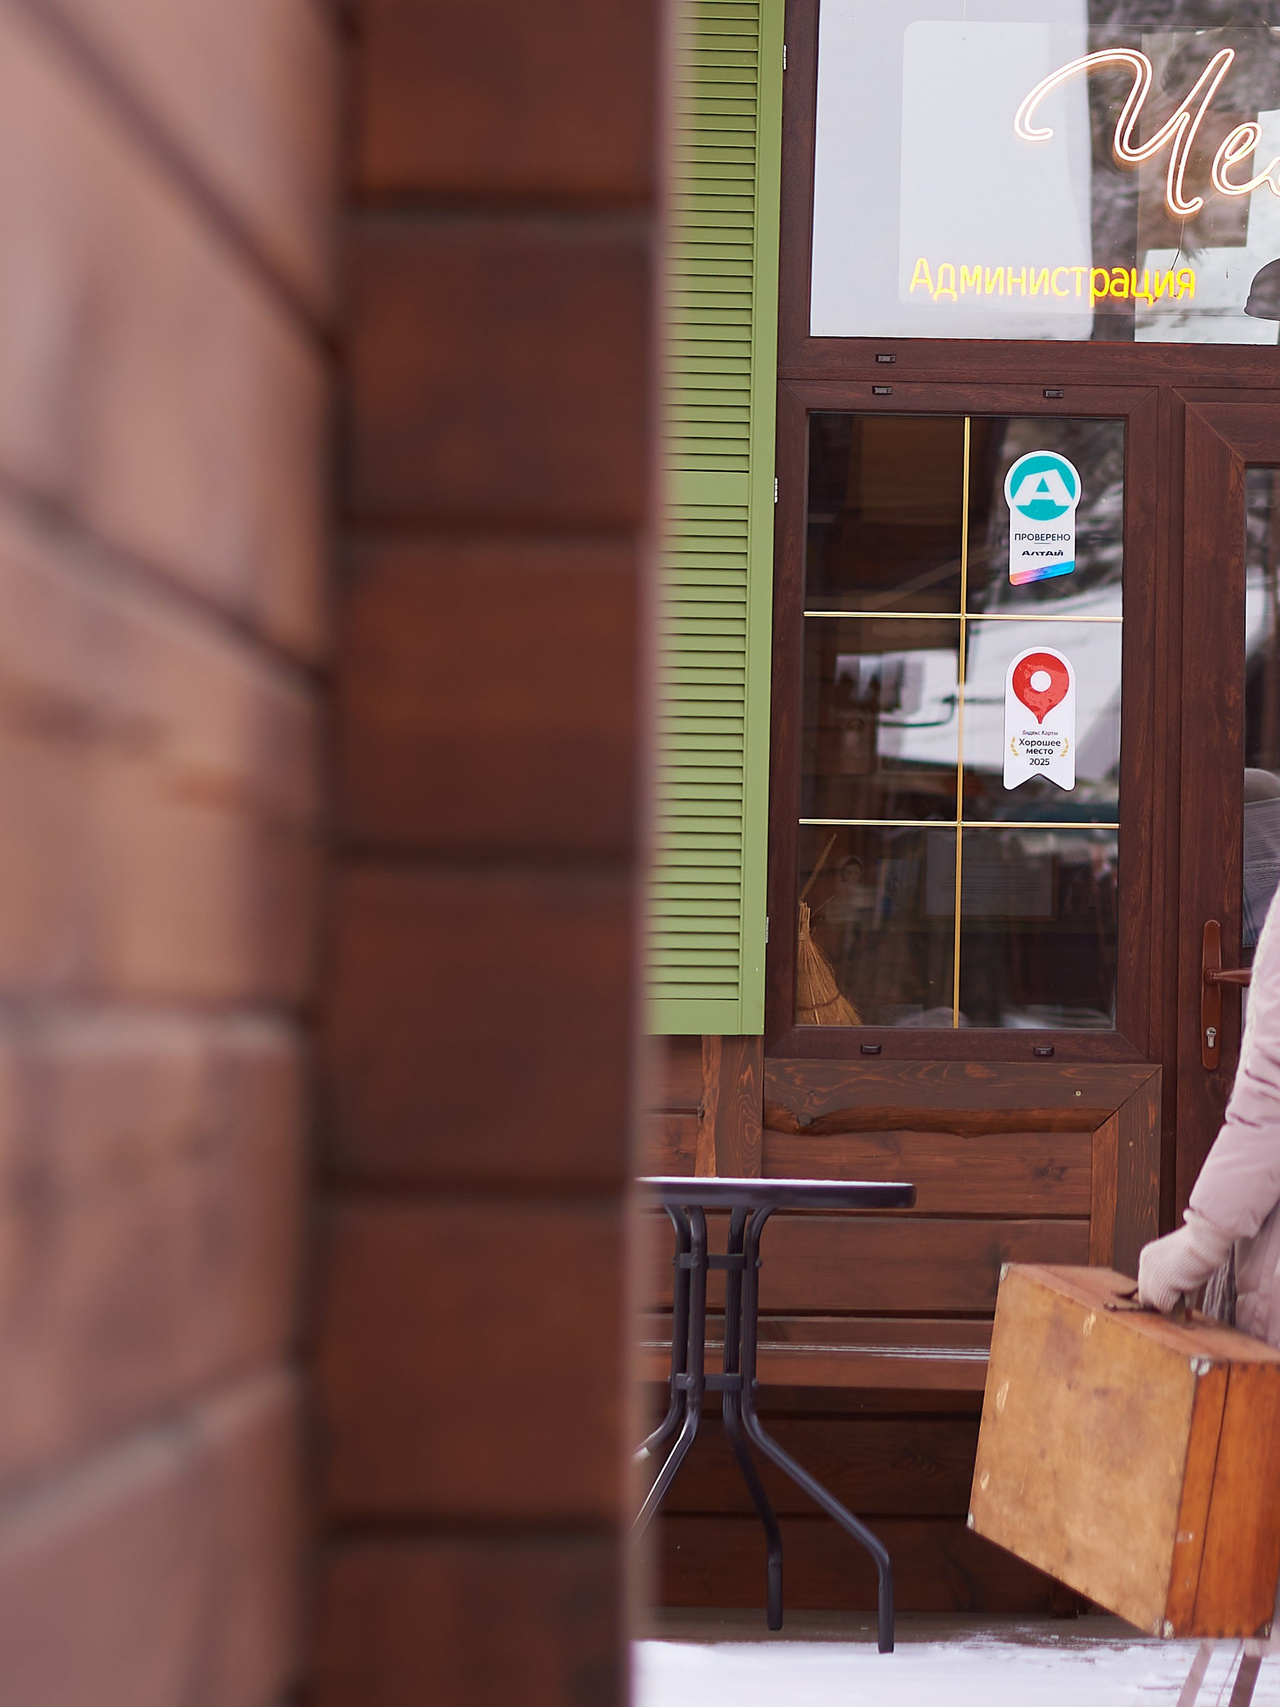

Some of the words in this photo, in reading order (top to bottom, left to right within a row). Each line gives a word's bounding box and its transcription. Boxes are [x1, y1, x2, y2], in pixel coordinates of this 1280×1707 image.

[909, 257, 1197, 307] Администрация
[1014, 533, 1071, 541] ПРОВЕРЕНО
[1019, 738, 1061, 747] Хорошее
[1029, 757, 1050, 766] 2025
